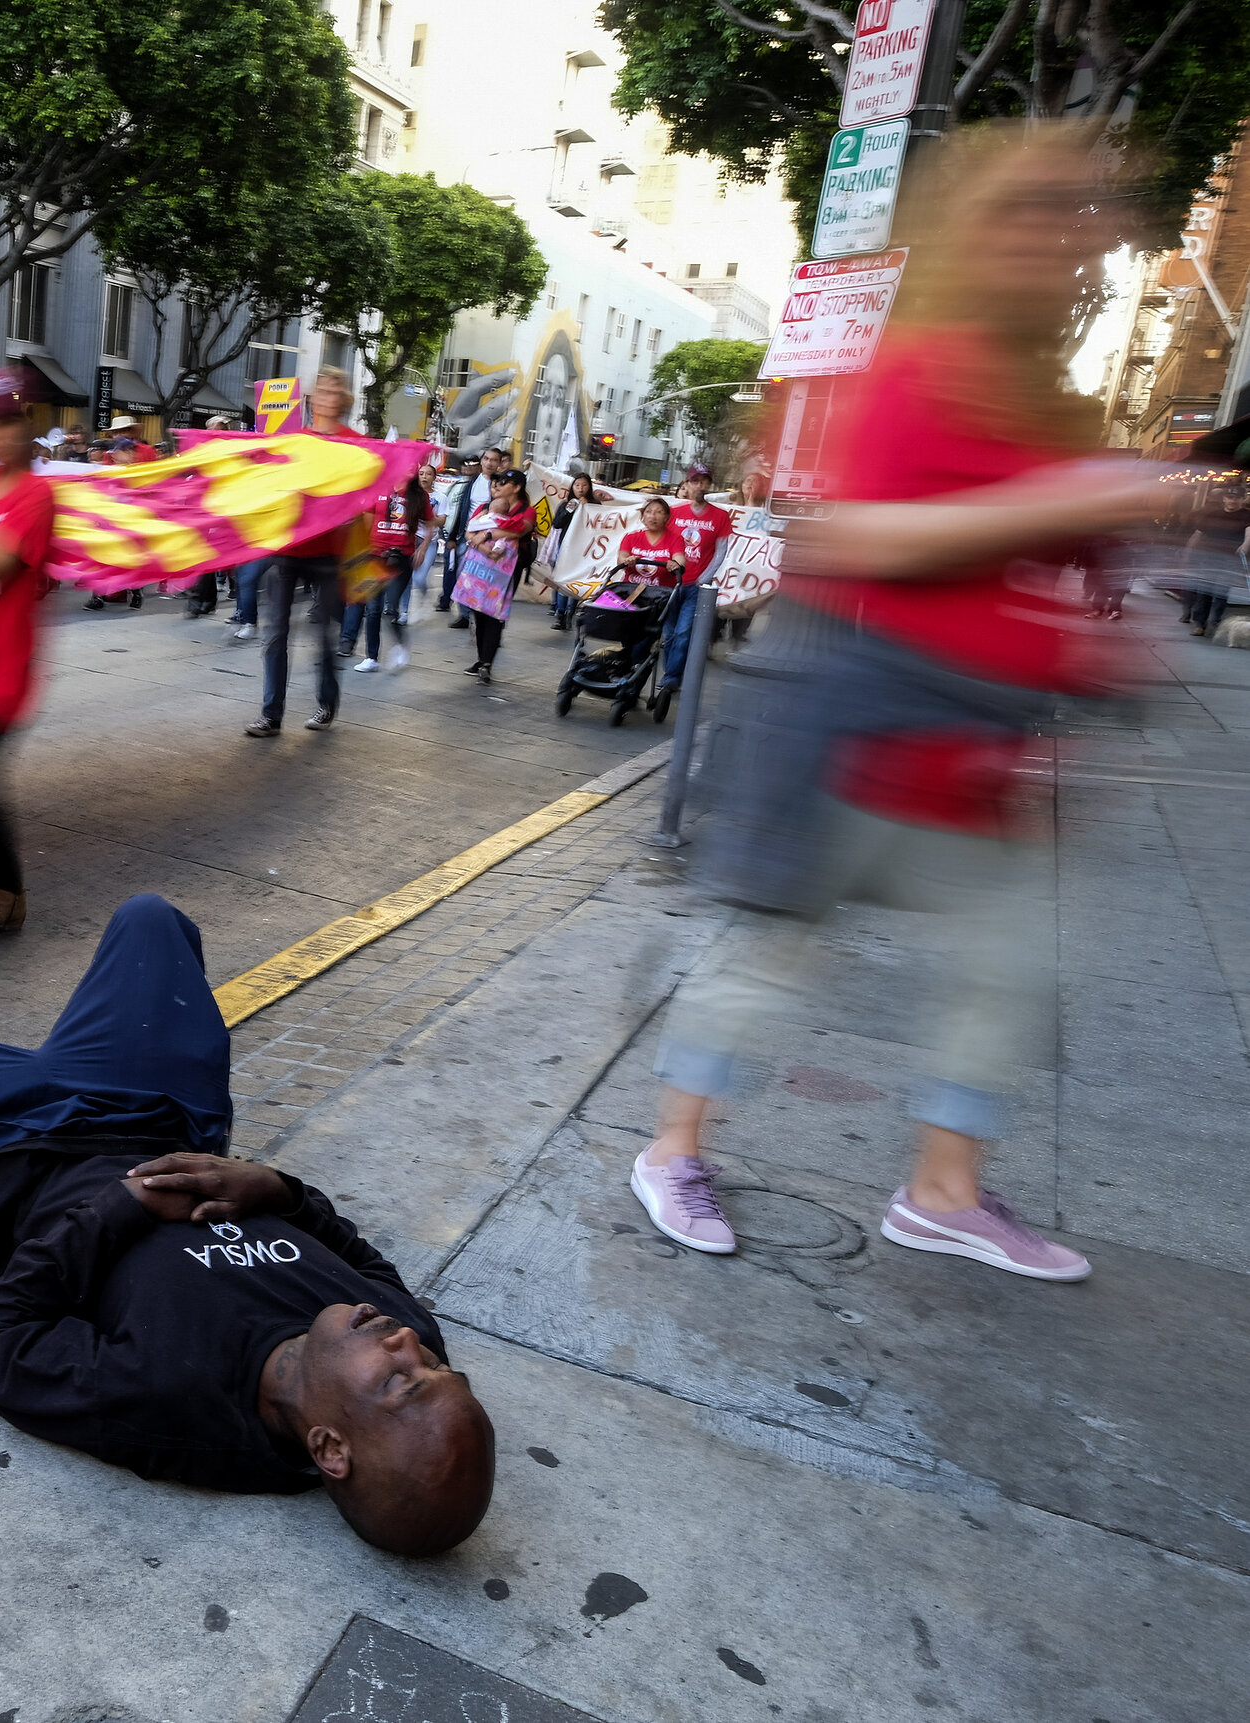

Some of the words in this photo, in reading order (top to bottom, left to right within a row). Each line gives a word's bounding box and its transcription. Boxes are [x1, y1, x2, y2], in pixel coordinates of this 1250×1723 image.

[861, 0, 888, 32] NO
[855, 26, 920, 64] PARKING
[851, 70, 874, 90] 2AM
[888, 61, 913, 81] 5AM
[855, 90, 901, 111] NIGHTLY
[837, 135, 858, 163] 2
[863, 132, 900, 153] HOUR
[826, 165, 897, 198] PARKING
[821, 207, 848, 225] 8AM
[806, 254, 894, 276] TOW-AWAY
[806, 271, 886, 289] TEMPORARY
[784, 292, 821, 321] NO
[821, 289, 889, 316] STOPPING
[842, 319, 875, 340] 7PM
[771, 349, 835, 362] WEDNESDAY
[838, 347, 867, 358] ONLY
[99, 370, 112, 408] Project
[98, 411, 110, 428] Pet
[586, 511, 628, 529] WHEN
[583, 535, 609, 560] IS
[183, 1239, 302, 1269] OWSLA
